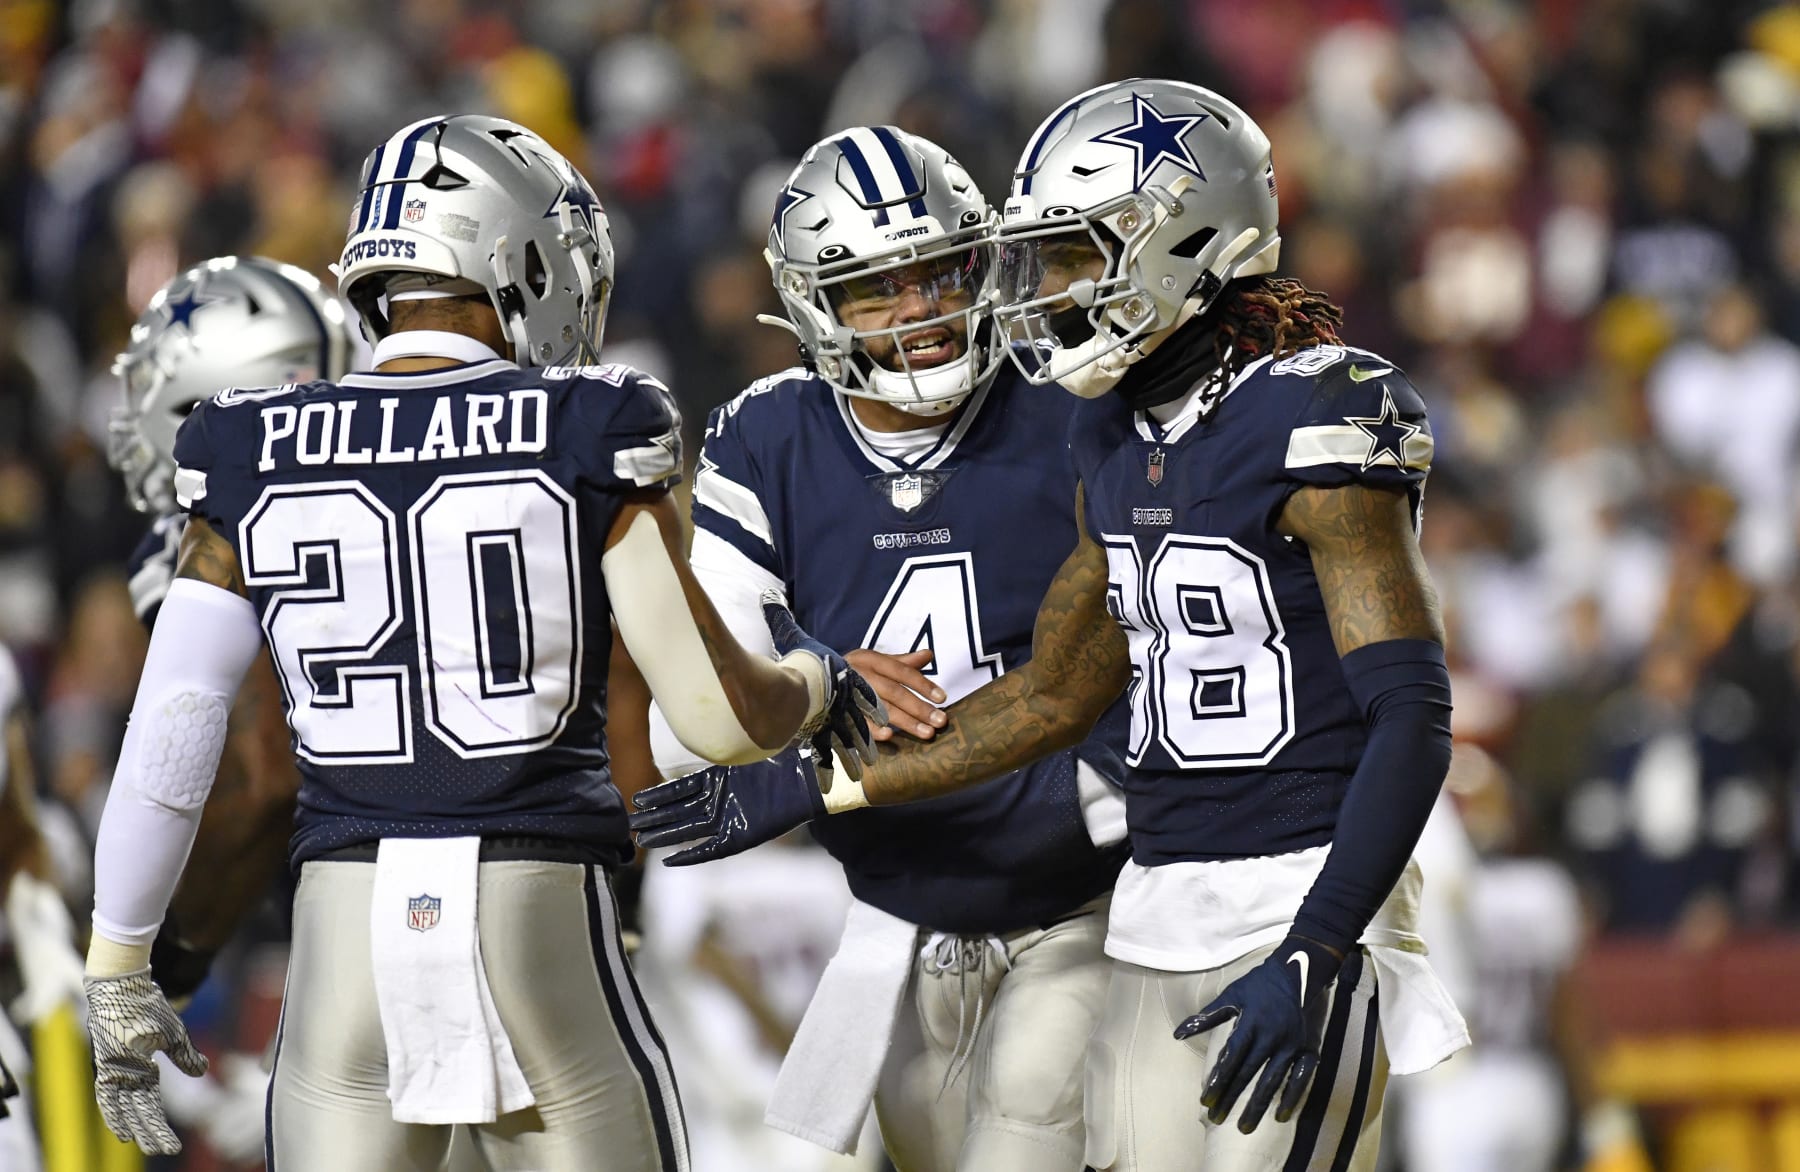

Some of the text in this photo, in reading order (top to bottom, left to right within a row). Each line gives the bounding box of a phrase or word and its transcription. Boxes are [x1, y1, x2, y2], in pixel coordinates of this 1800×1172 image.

[406, 208, 422, 220] NFL
[343, 239, 416, 272] COWBOYS
[258, 389, 548, 472] POLLARD
[1133, 508, 1173, 525] COWBOYS
[873, 528, 951, 549] COWBOYS
[238, 468, 584, 766] 20
[860, 551, 1005, 709] 4
[411, 911, 437, 928] NFL
